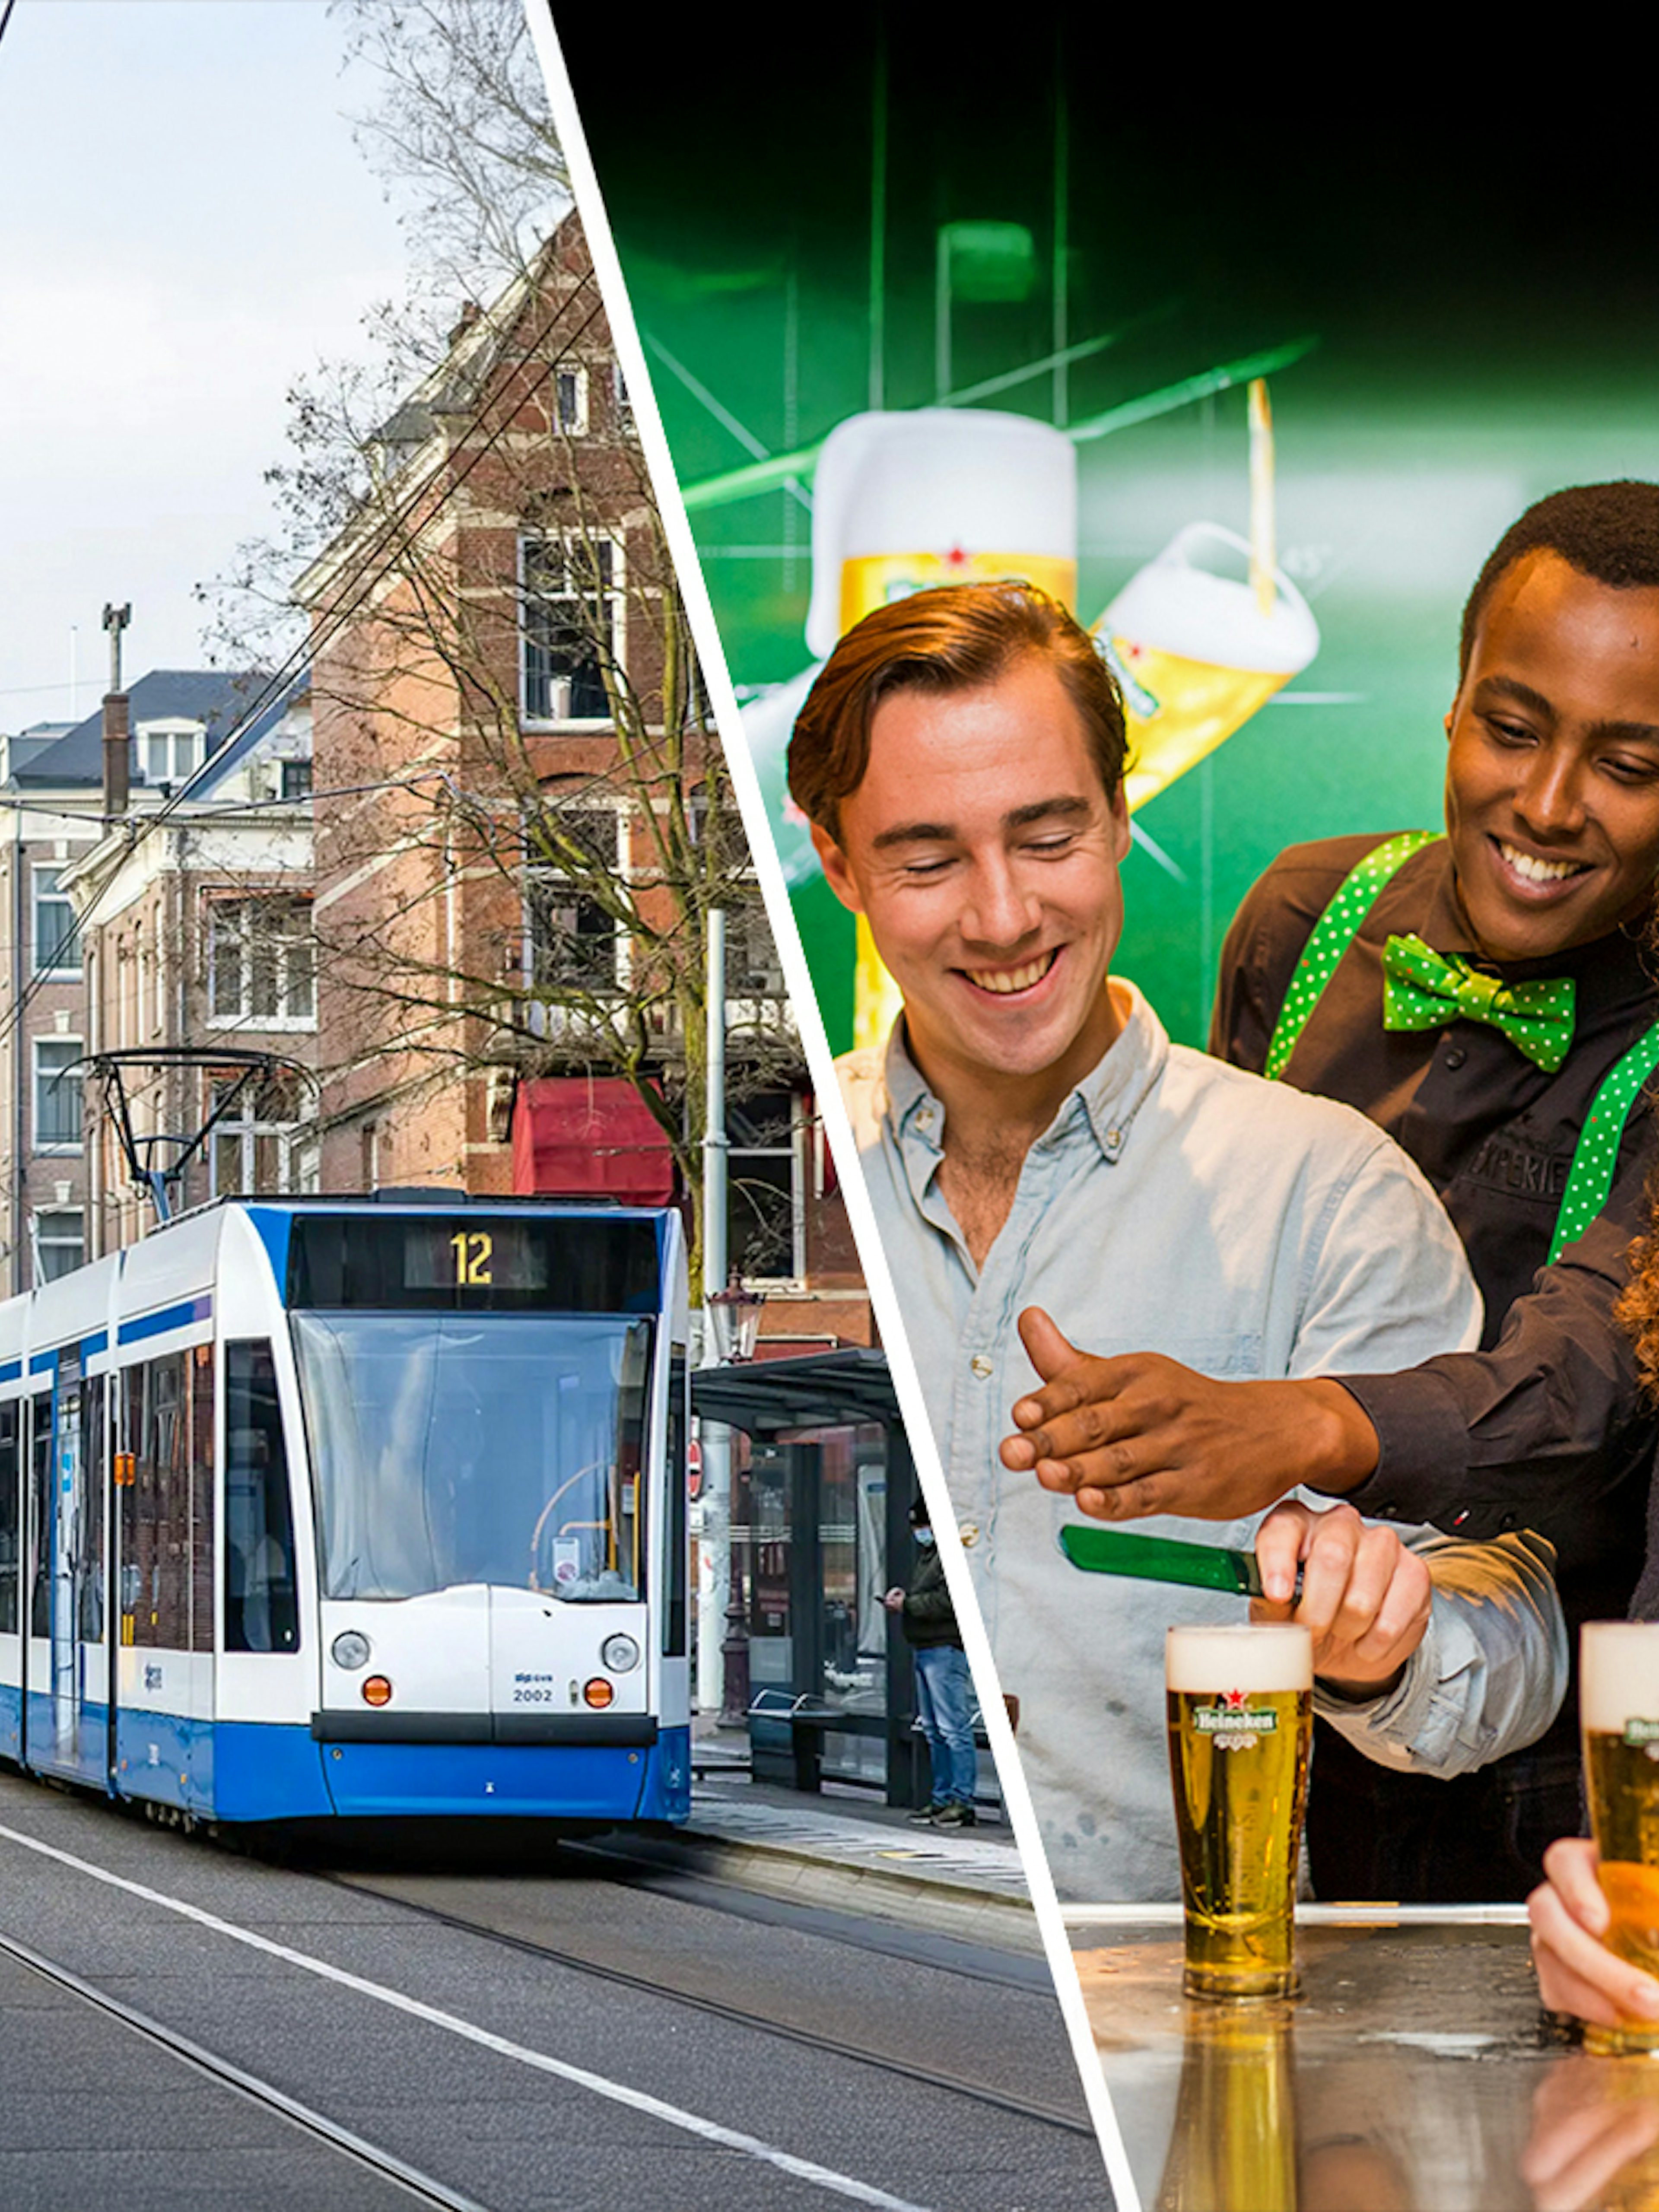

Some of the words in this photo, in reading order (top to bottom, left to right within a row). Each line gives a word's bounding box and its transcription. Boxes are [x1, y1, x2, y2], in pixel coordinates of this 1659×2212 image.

[450, 1232, 493, 1285] 12
[513, 1689, 553, 1702] 2002
[1198, 1712, 1274, 1729] Heineken
